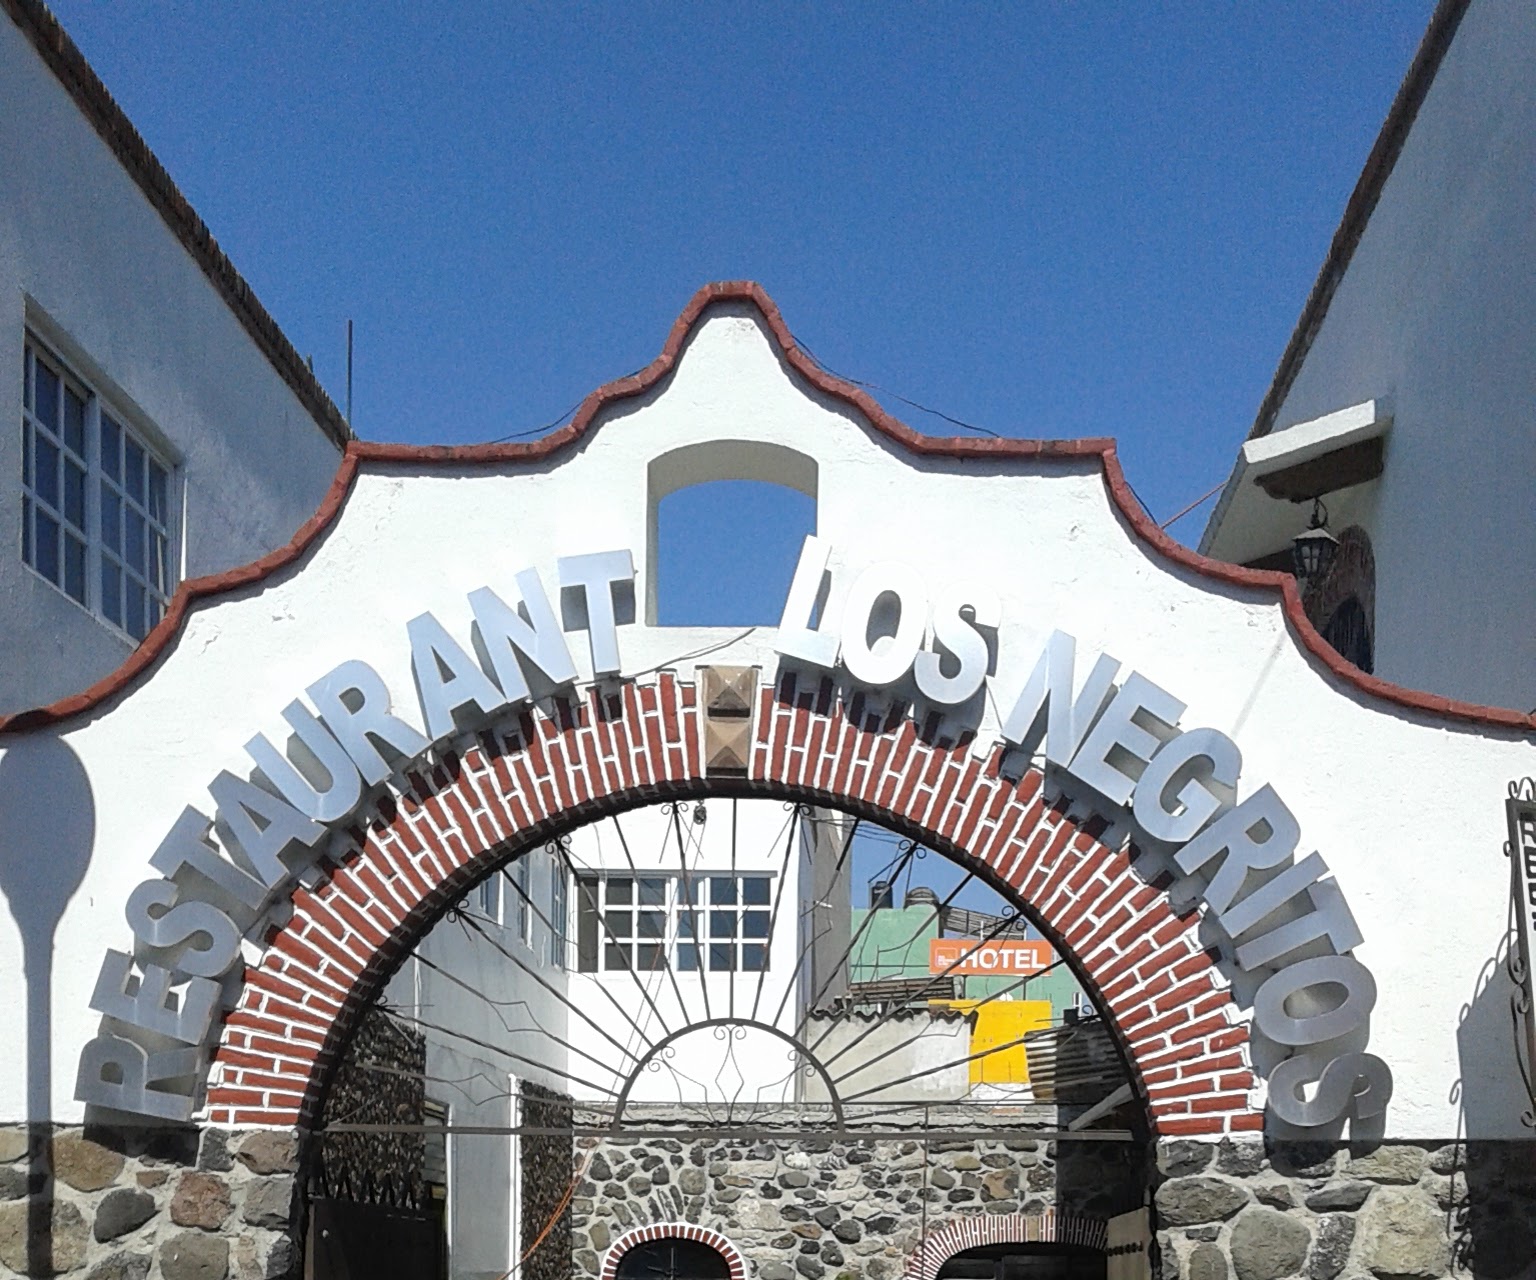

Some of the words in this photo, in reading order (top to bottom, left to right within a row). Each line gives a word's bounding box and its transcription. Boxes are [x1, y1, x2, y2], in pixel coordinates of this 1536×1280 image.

[73, 549, 635, 1122] RESTAURANT
[773, 534, 1000, 705] LOS
[1000, 629, 1394, 1127] NEGRITOS
[960, 947, 1047, 969] HOTEL
